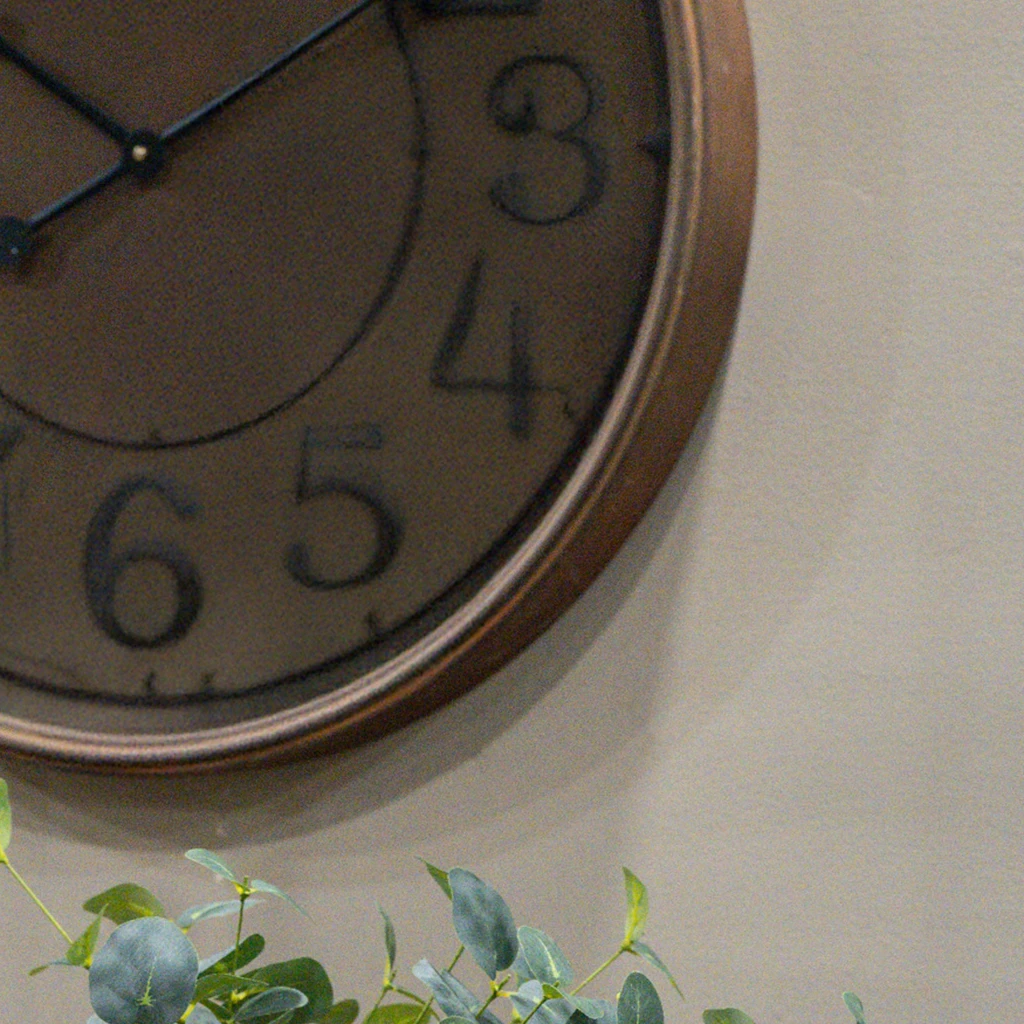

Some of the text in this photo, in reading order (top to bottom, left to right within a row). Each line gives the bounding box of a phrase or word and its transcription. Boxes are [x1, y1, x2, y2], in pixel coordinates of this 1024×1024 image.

[487, 55, 605, 225] 3
[429, 250, 566, 440] 4
[84, 475, 203, 649] 6
[284, 423, 404, 591] 5
